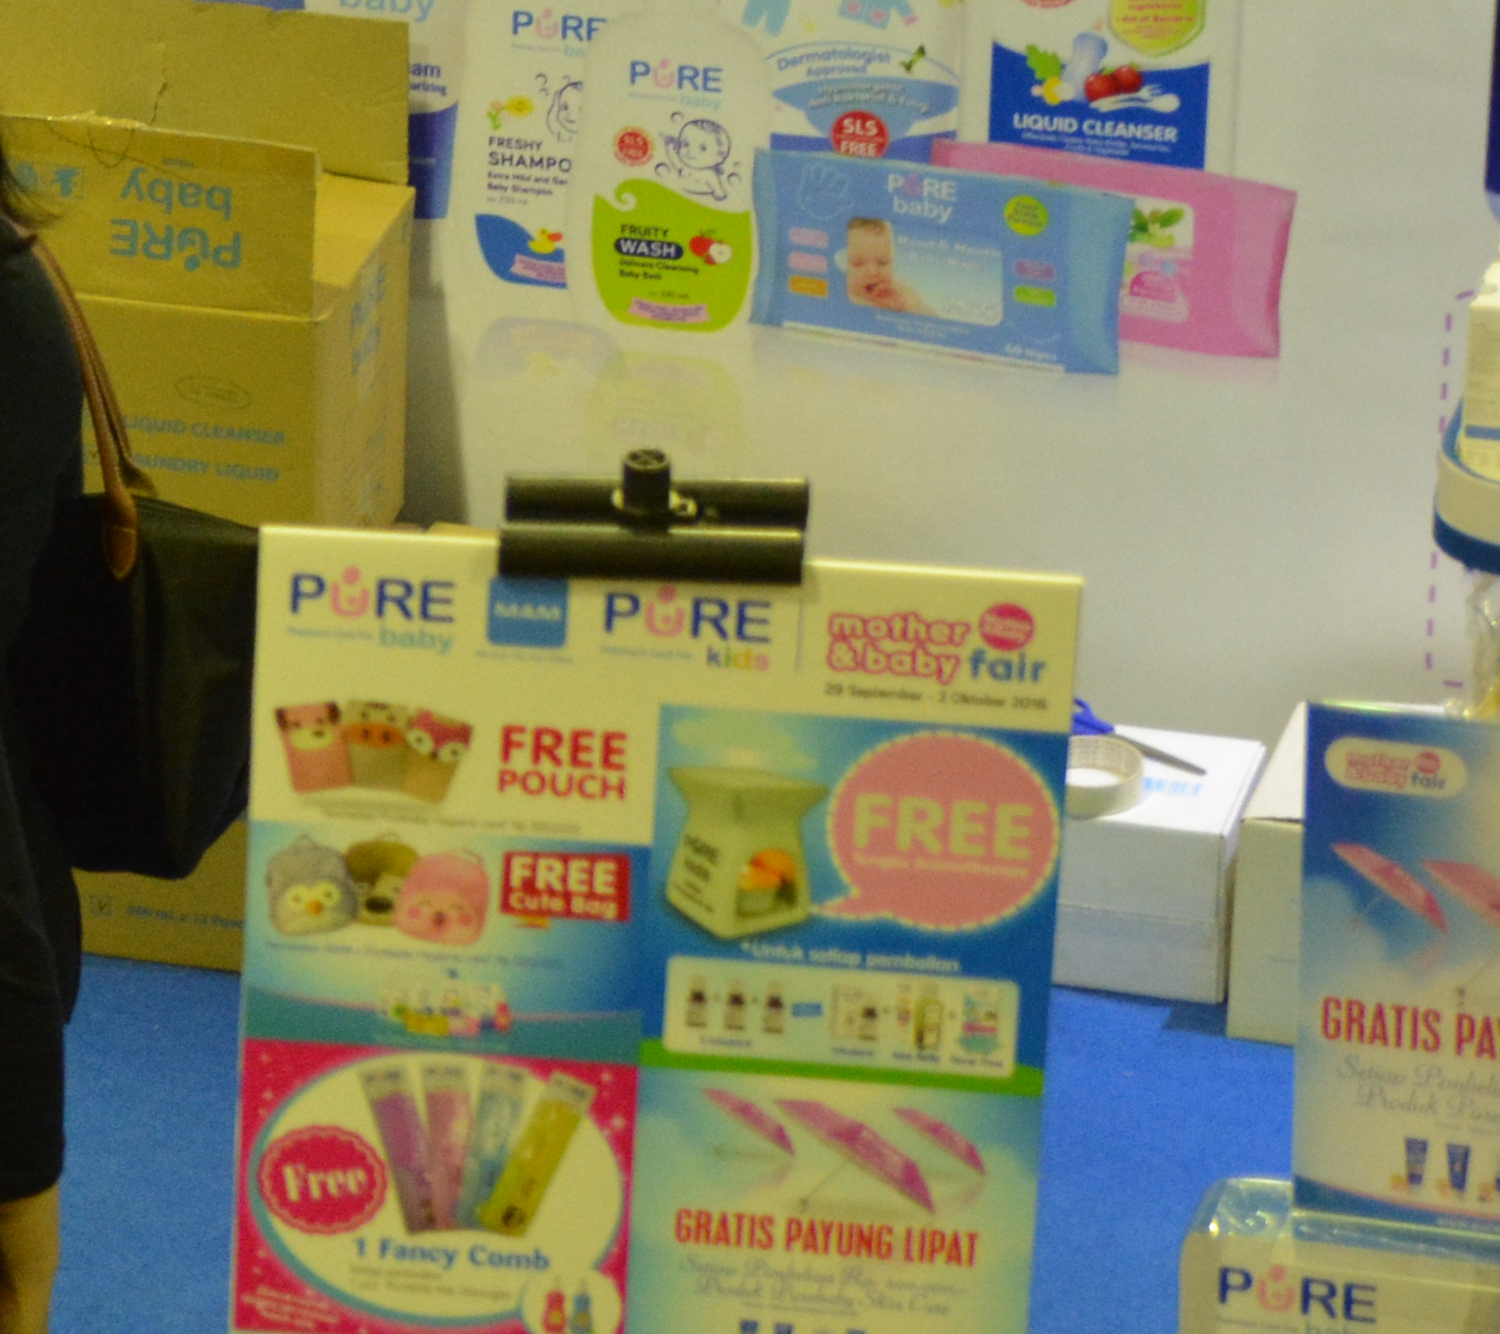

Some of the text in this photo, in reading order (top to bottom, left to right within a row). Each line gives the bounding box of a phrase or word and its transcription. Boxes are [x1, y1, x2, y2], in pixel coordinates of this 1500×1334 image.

[777, 46, 891, 72] Dermatologist
[629, 58, 723, 94] PURE
[488, 135, 543, 151] FRESHY
[842, 118, 878, 137] SLS
[1013, 112, 1178, 143] LIQUID CLEANSER
[893, 194, 953, 224] baby
[620, 224, 670, 238] FRUITY
[620, 239, 676, 257] WASH
[290, 566, 457, 625] PURE
[603, 582, 772, 644] PURE
[828, 611, 971, 646] mother
[706, 644, 771, 672] kids
[969, 648, 1046, 682] fair
[848, 685, 922, 702] September
[499, 724, 628, 771] FREE
[497, 770, 627, 802] POUCH
[1410, 769, 1447, 791] fair
[853, 791, 1034, 860] FREE
[508, 855, 617, 896] FREE
[508, 891, 617, 920] Cute Bag
[1319, 995, 1441, 1053] GRATIS
[282, 1164, 367, 1203] Free
[674, 1208, 979, 1267] GRATIS PAYUNG LIPAT
[379, 1240, 549, 1270] Fancy Comb
[1217, 1264, 1378, 1324] PURE
